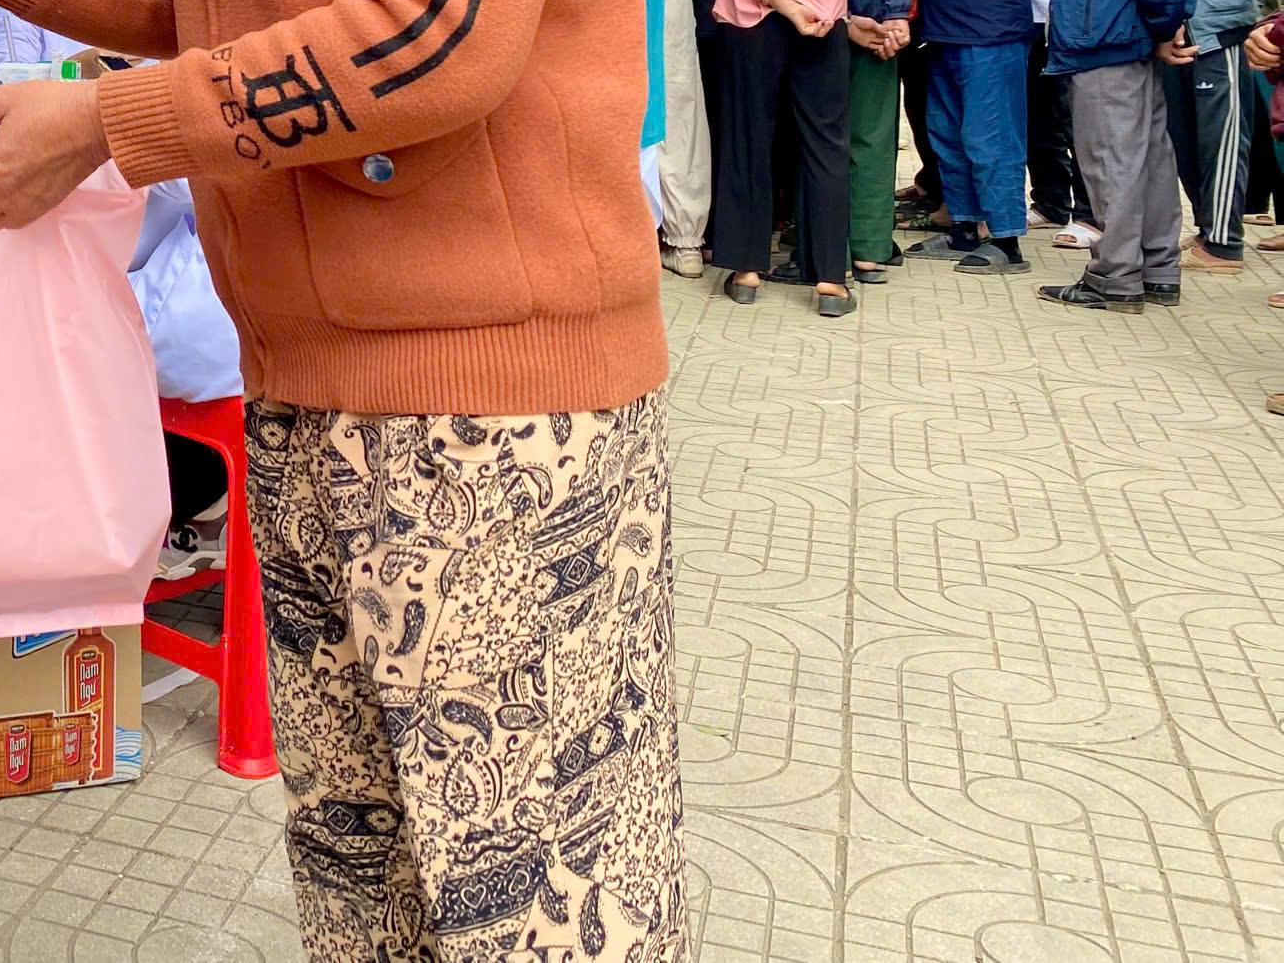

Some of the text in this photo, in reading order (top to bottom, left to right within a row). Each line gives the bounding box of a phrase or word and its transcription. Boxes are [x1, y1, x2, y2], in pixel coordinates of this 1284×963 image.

[211, 46, 272, 169] BTBO
[80, 662, 99, 682] Nam
[79, 679, 97, 708] Ngư
[9, 737, 27, 753] Nam
[9, 752, 25, 776] Ngư
